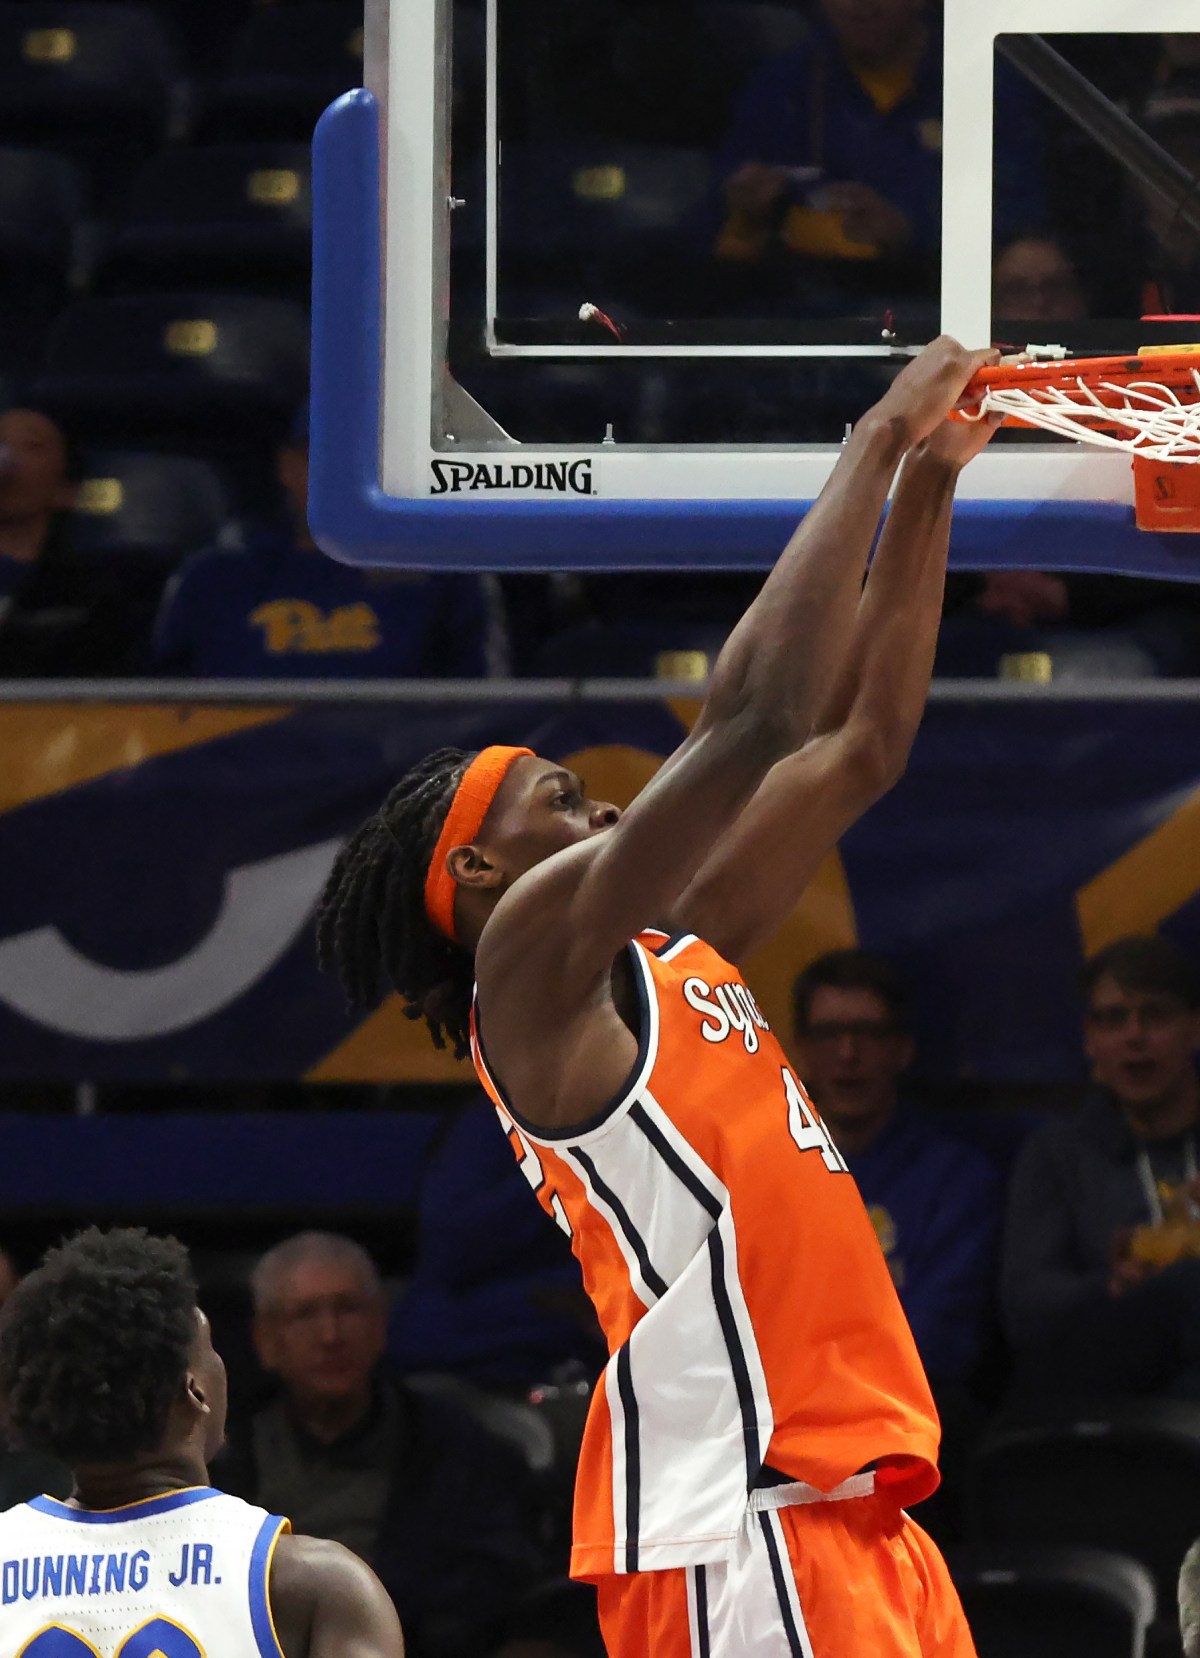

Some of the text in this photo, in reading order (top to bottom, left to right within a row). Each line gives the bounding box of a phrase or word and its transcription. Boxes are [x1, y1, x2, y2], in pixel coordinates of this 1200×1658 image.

[430, 458, 592, 495] SPALDING
[781, 1065, 850, 1174] 4
[1, 1543, 223, 1605] DUNNING JR.
